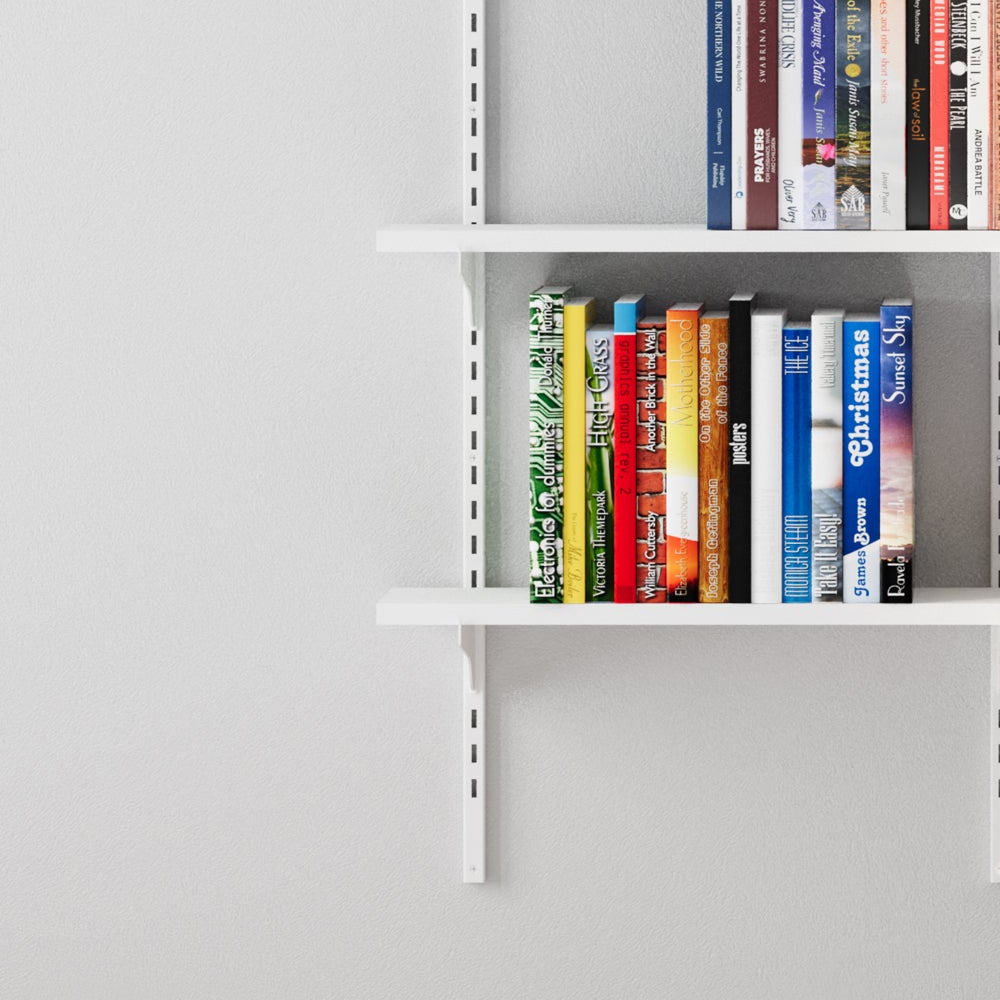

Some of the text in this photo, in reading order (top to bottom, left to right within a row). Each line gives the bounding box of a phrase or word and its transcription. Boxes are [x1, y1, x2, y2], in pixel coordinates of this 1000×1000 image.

[847, 0, 857, 11] of
[847, 15, 859, 31] the
[880, 17, 889, 31] and
[950, 2, 967, 49] STEINBECK
[715, 11, 723, 58] NORTHERN
[781, 35, 796, 68] CRISIS
[847, 35, 859, 61] Exile
[880, 34, 889, 55] other
[934, 40, 945, 65] WOOD
[715, 59, 723, 82] WILD
[813, 50, 826, 86] Maid
[880, 59, 889, 76] short
[880, 79, 888, 104] stories
[950, 88, 967, 130] THE PEARL
[845, 79, 860, 167] Janis Susan May
[754, 128, 764, 182] PRAYERS
[934, 146, 945, 195] MURAKAMI
[974, 129, 983, 195] ANDREA BATTLE
[783, 179, 794, 202] Oliver
[840, 197, 866, 212] SAB
[538, 346, 554, 386] Donald
[586, 337, 609, 393] GRASS
[620, 341, 631, 396] graphics
[670, 319, 694, 426] Motherhood
[784, 336, 808, 375] THE ICE
[883, 315, 910, 404] Sunset Sky
[645, 328, 656, 452] Another Brick in the Wall
[700, 324, 711, 443] On the Other Side
[716, 343, 727, 424] of the Fence
[848, 330, 873, 466] Christmas
[619, 404, 630, 443] annual
[729, 423, 750, 465] posters
[620, 453, 630, 478] rev.
[535, 422, 556, 598] Electronics for dummies
[645, 511, 657, 598] William Cuttersby
[784, 515, 808, 553] STEAM
[813, 513, 841, 597] Take It Easy!
[854, 498, 870, 596] James Brown
